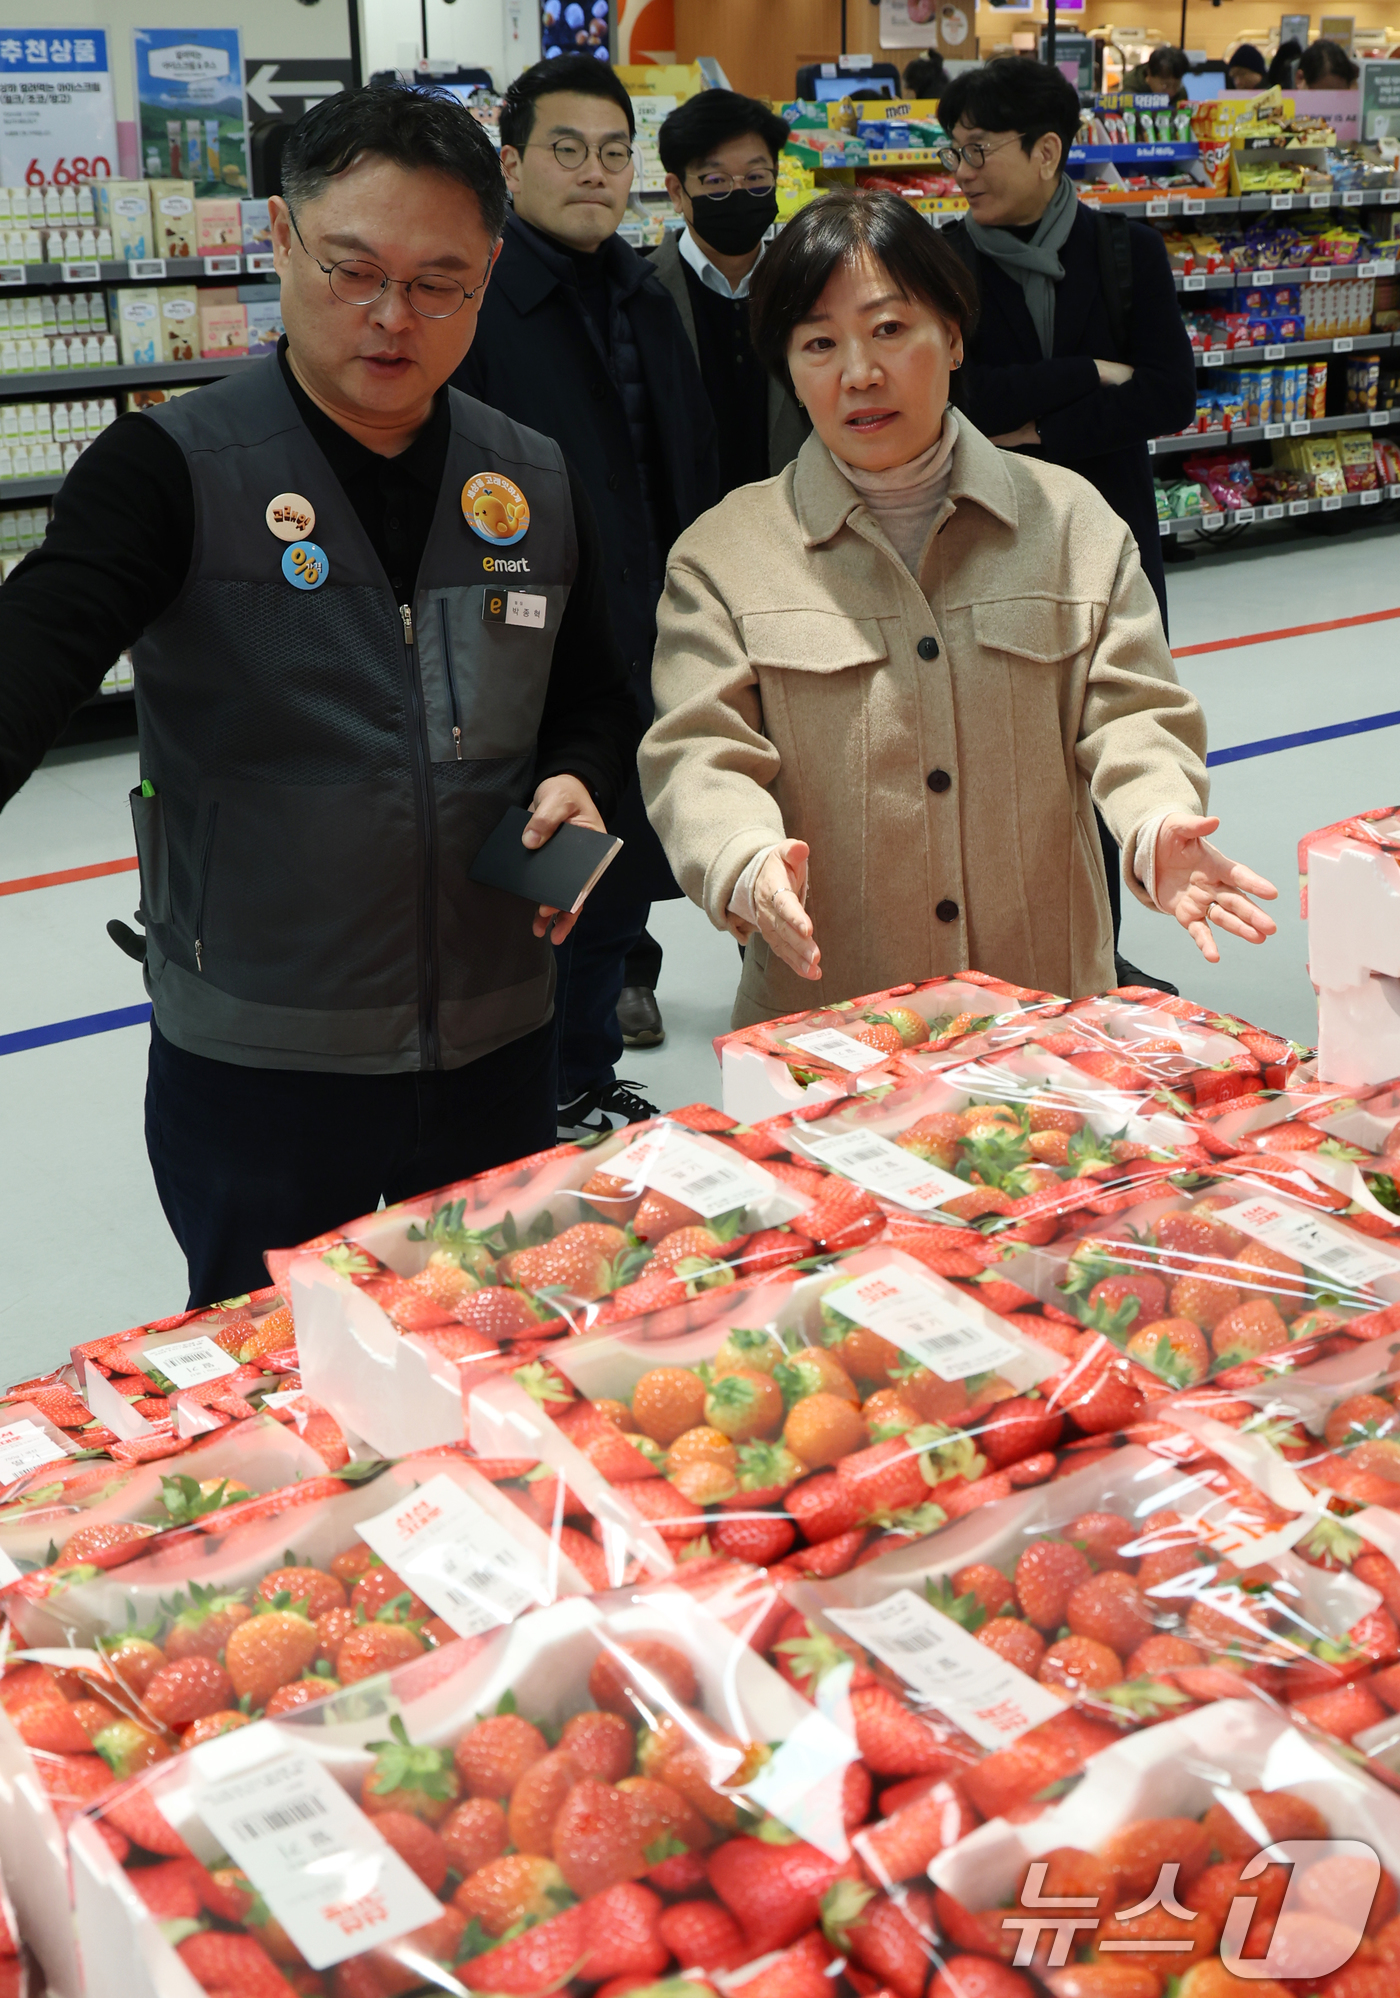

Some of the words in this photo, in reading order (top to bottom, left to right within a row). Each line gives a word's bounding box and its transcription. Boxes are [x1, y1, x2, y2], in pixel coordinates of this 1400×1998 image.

[0, 39, 97, 63] 추천상품
[57, 82, 101, 93] 아이스크림
[467, 478, 485, 500] 세상을
[272, 506, 311, 531] 고래잇
[482, 556, 531, 573] emart
